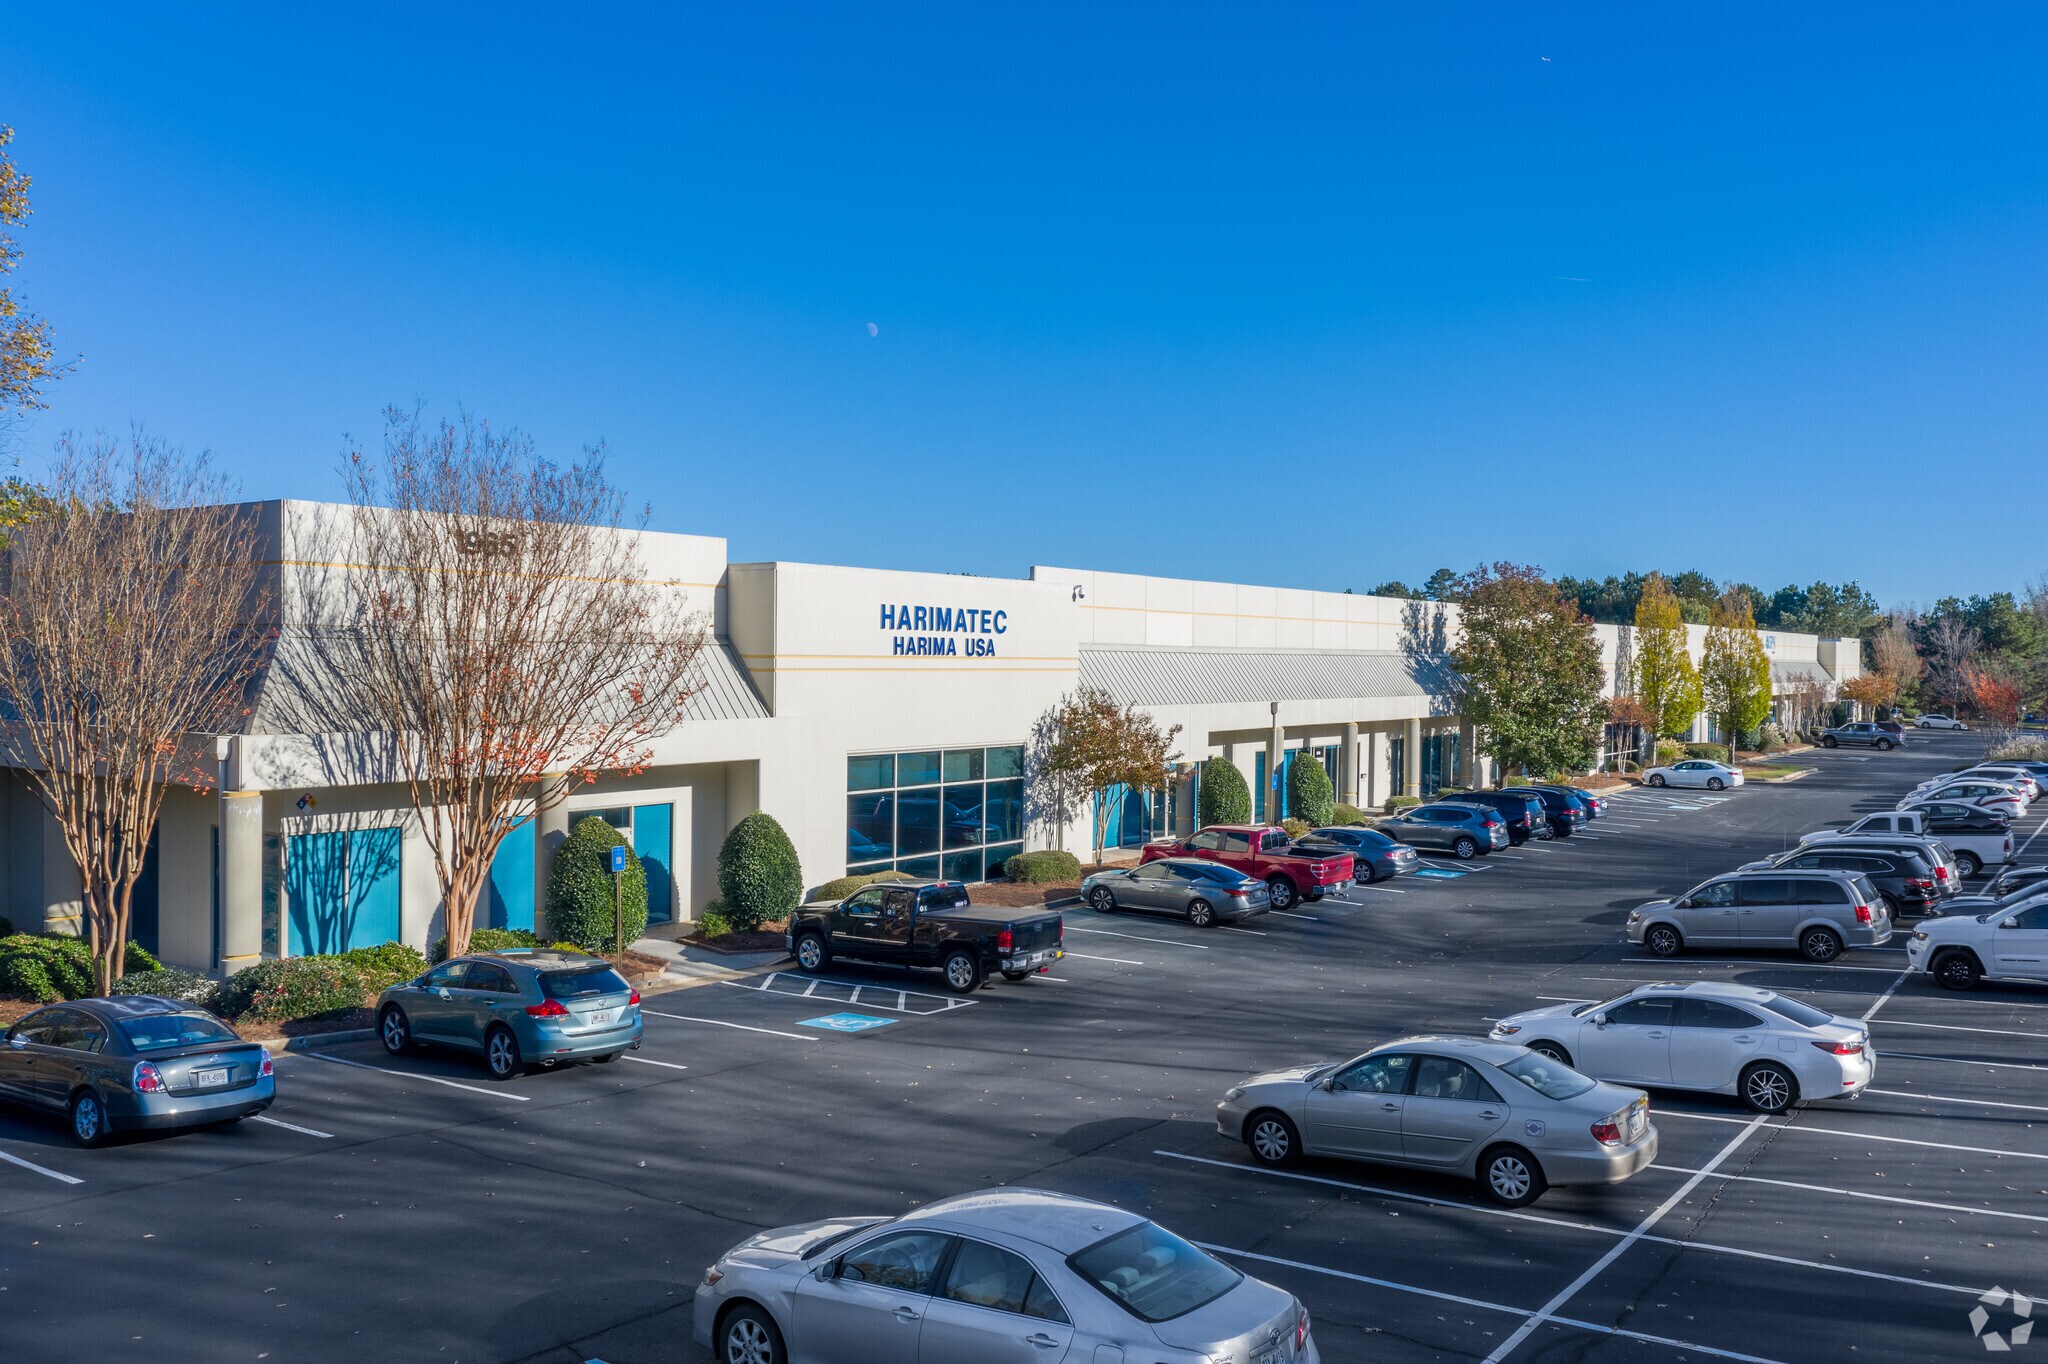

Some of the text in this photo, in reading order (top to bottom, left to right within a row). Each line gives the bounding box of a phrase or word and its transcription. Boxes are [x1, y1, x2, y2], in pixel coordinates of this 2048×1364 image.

[880, 604, 1007, 634] HARIMATEC
[893, 636, 996, 657] HARIMA USA
